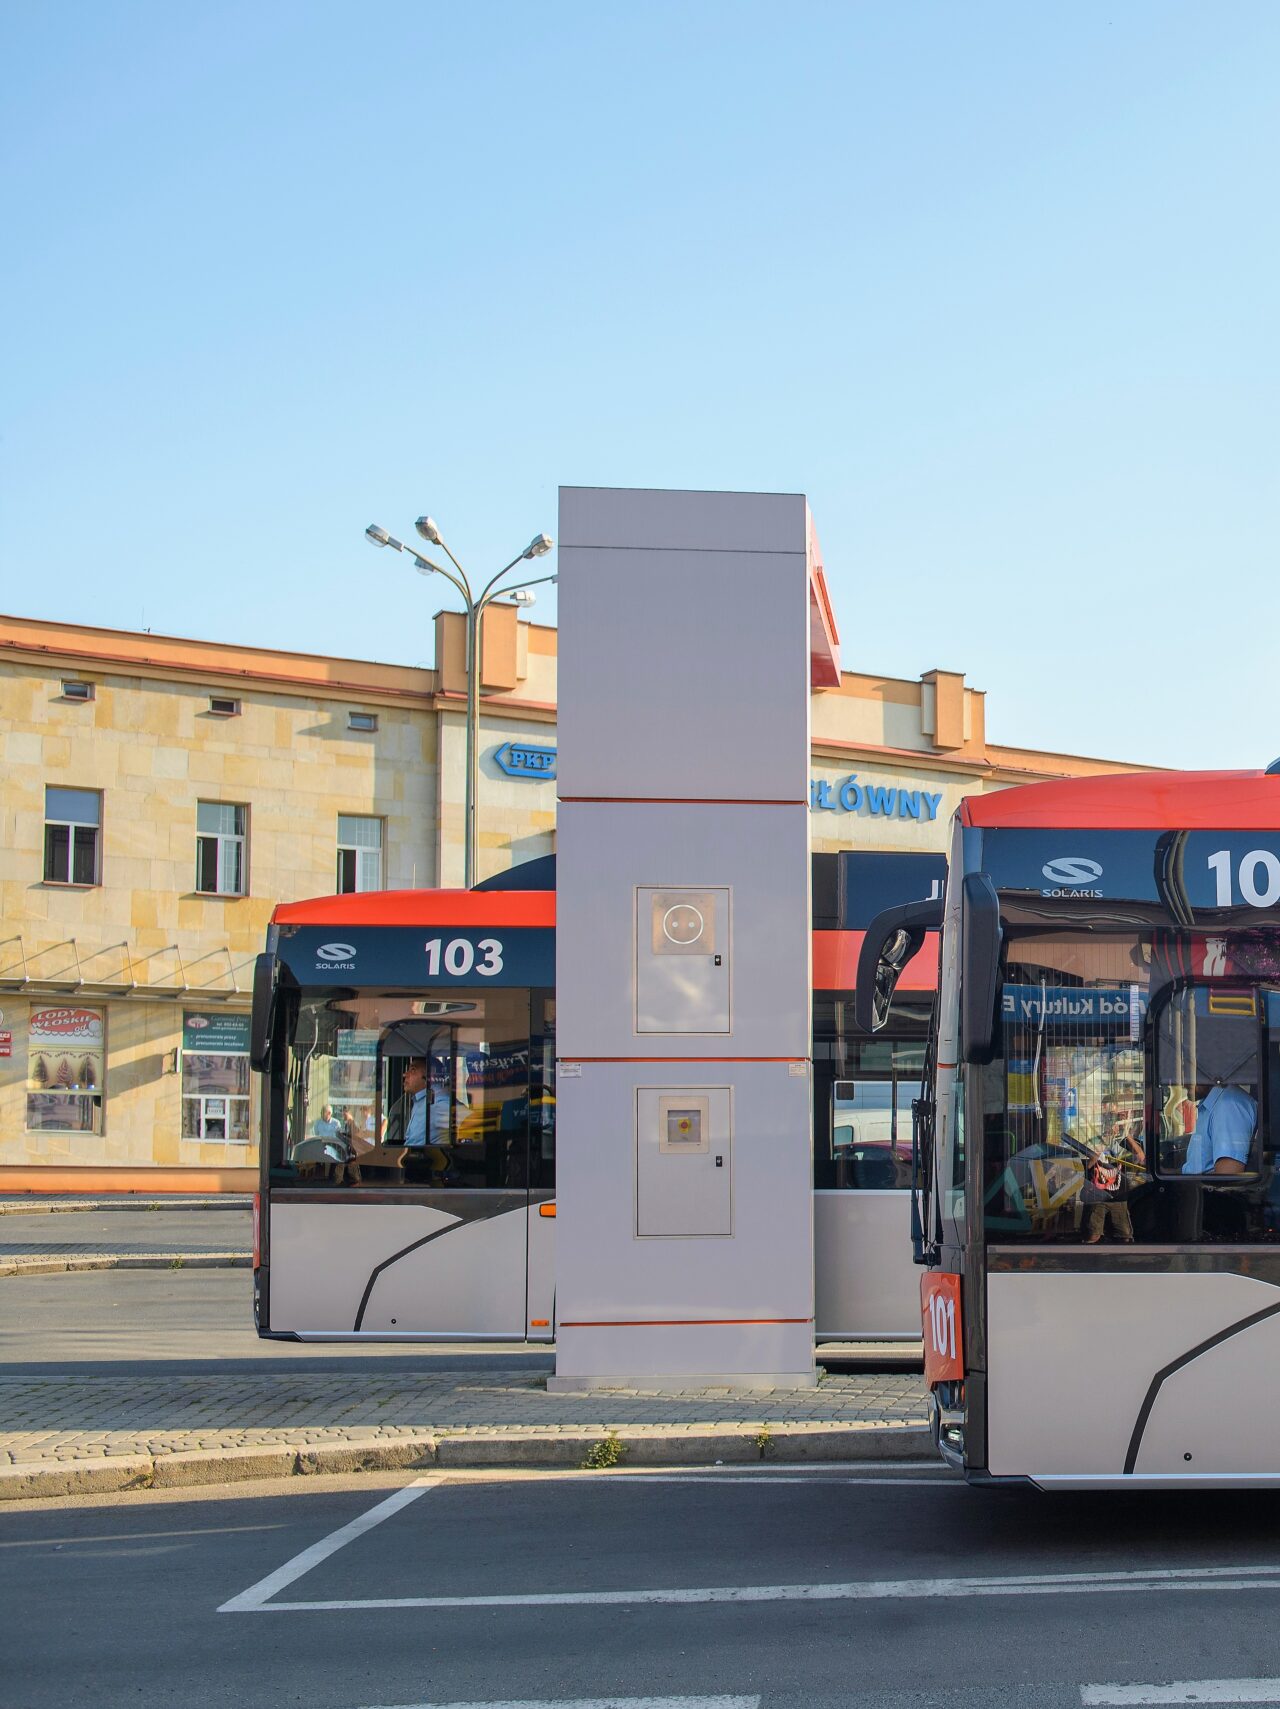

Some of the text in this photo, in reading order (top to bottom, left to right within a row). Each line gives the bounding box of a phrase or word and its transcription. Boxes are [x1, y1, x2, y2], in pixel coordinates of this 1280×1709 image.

[511, 751, 555, 769] PKP
[811, 774, 942, 820] ŁÓWNY
[1042, 889, 1103, 898] SOLARIS
[425, 939, 504, 976] 103
[37, 1009, 77, 1020] LODY
[929, 1294, 956, 1360] 101
